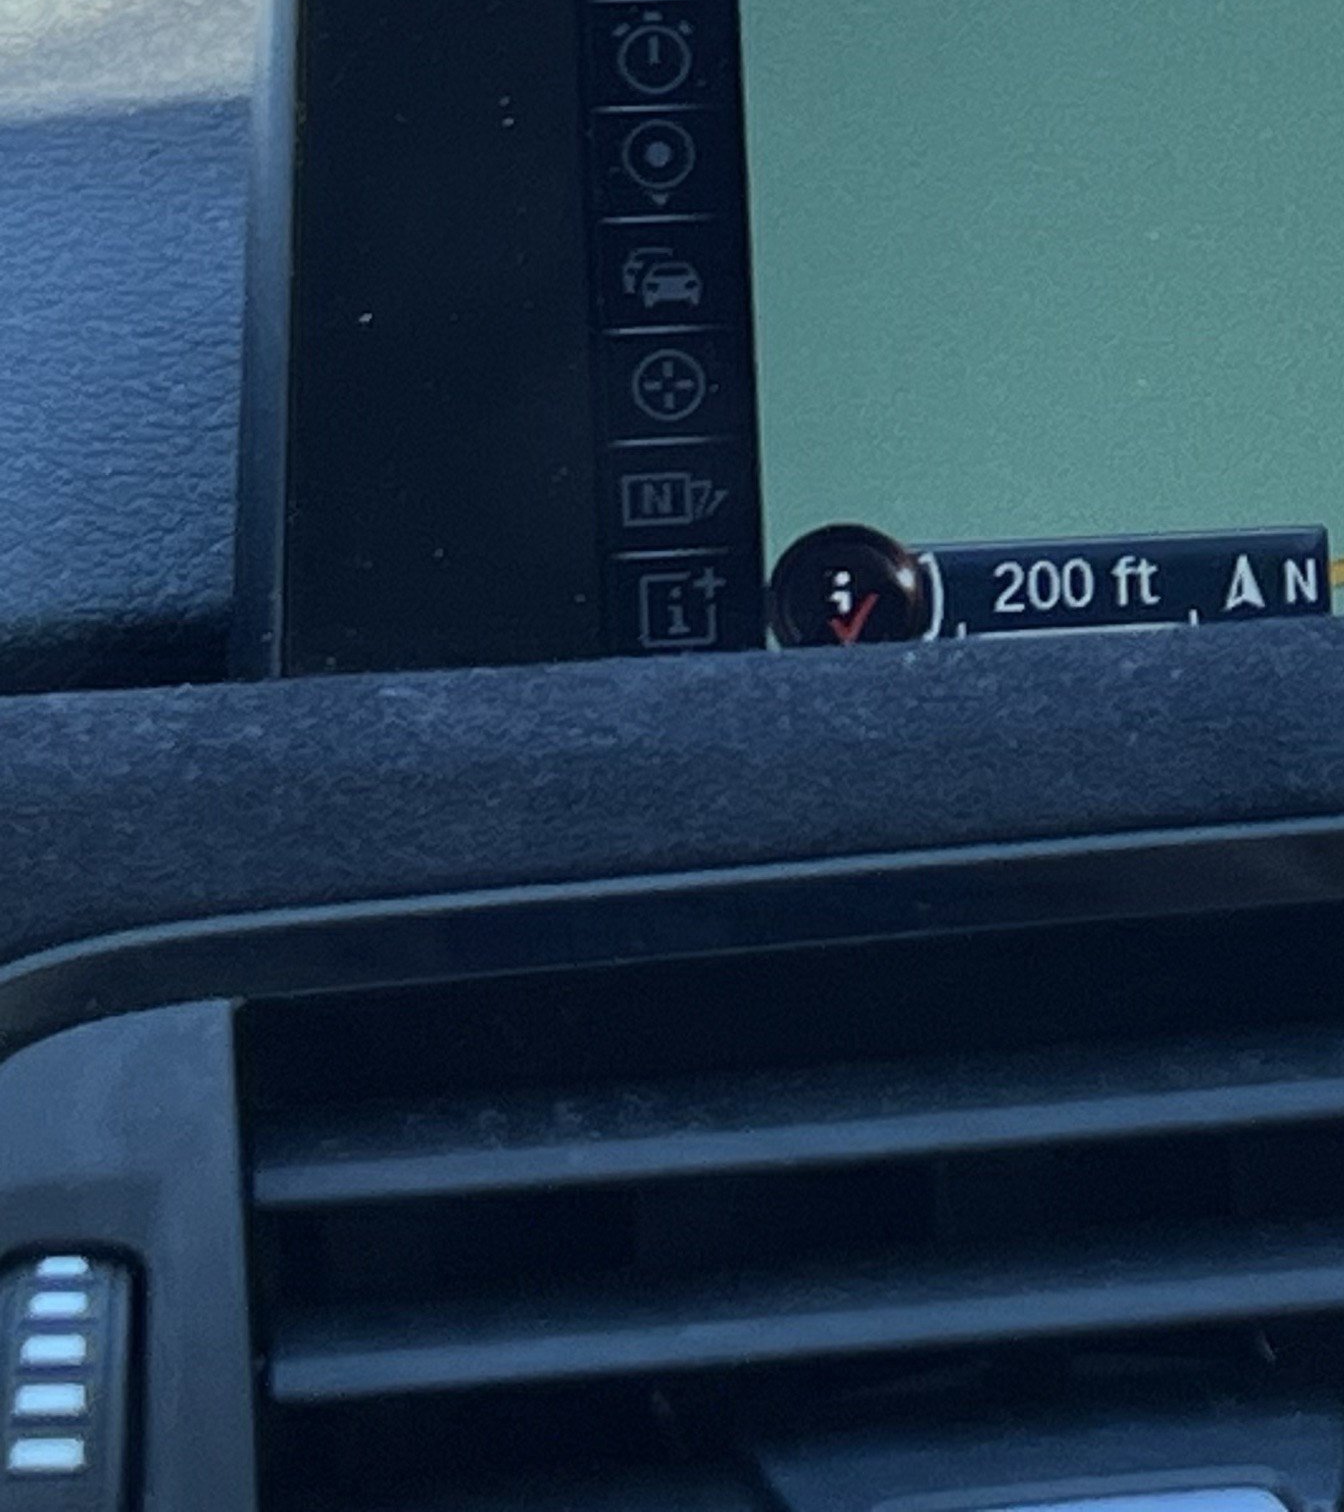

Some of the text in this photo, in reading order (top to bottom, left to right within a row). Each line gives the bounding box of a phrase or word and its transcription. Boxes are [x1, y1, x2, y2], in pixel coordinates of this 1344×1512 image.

[993, 555, 1318, 613] 200 ft N
